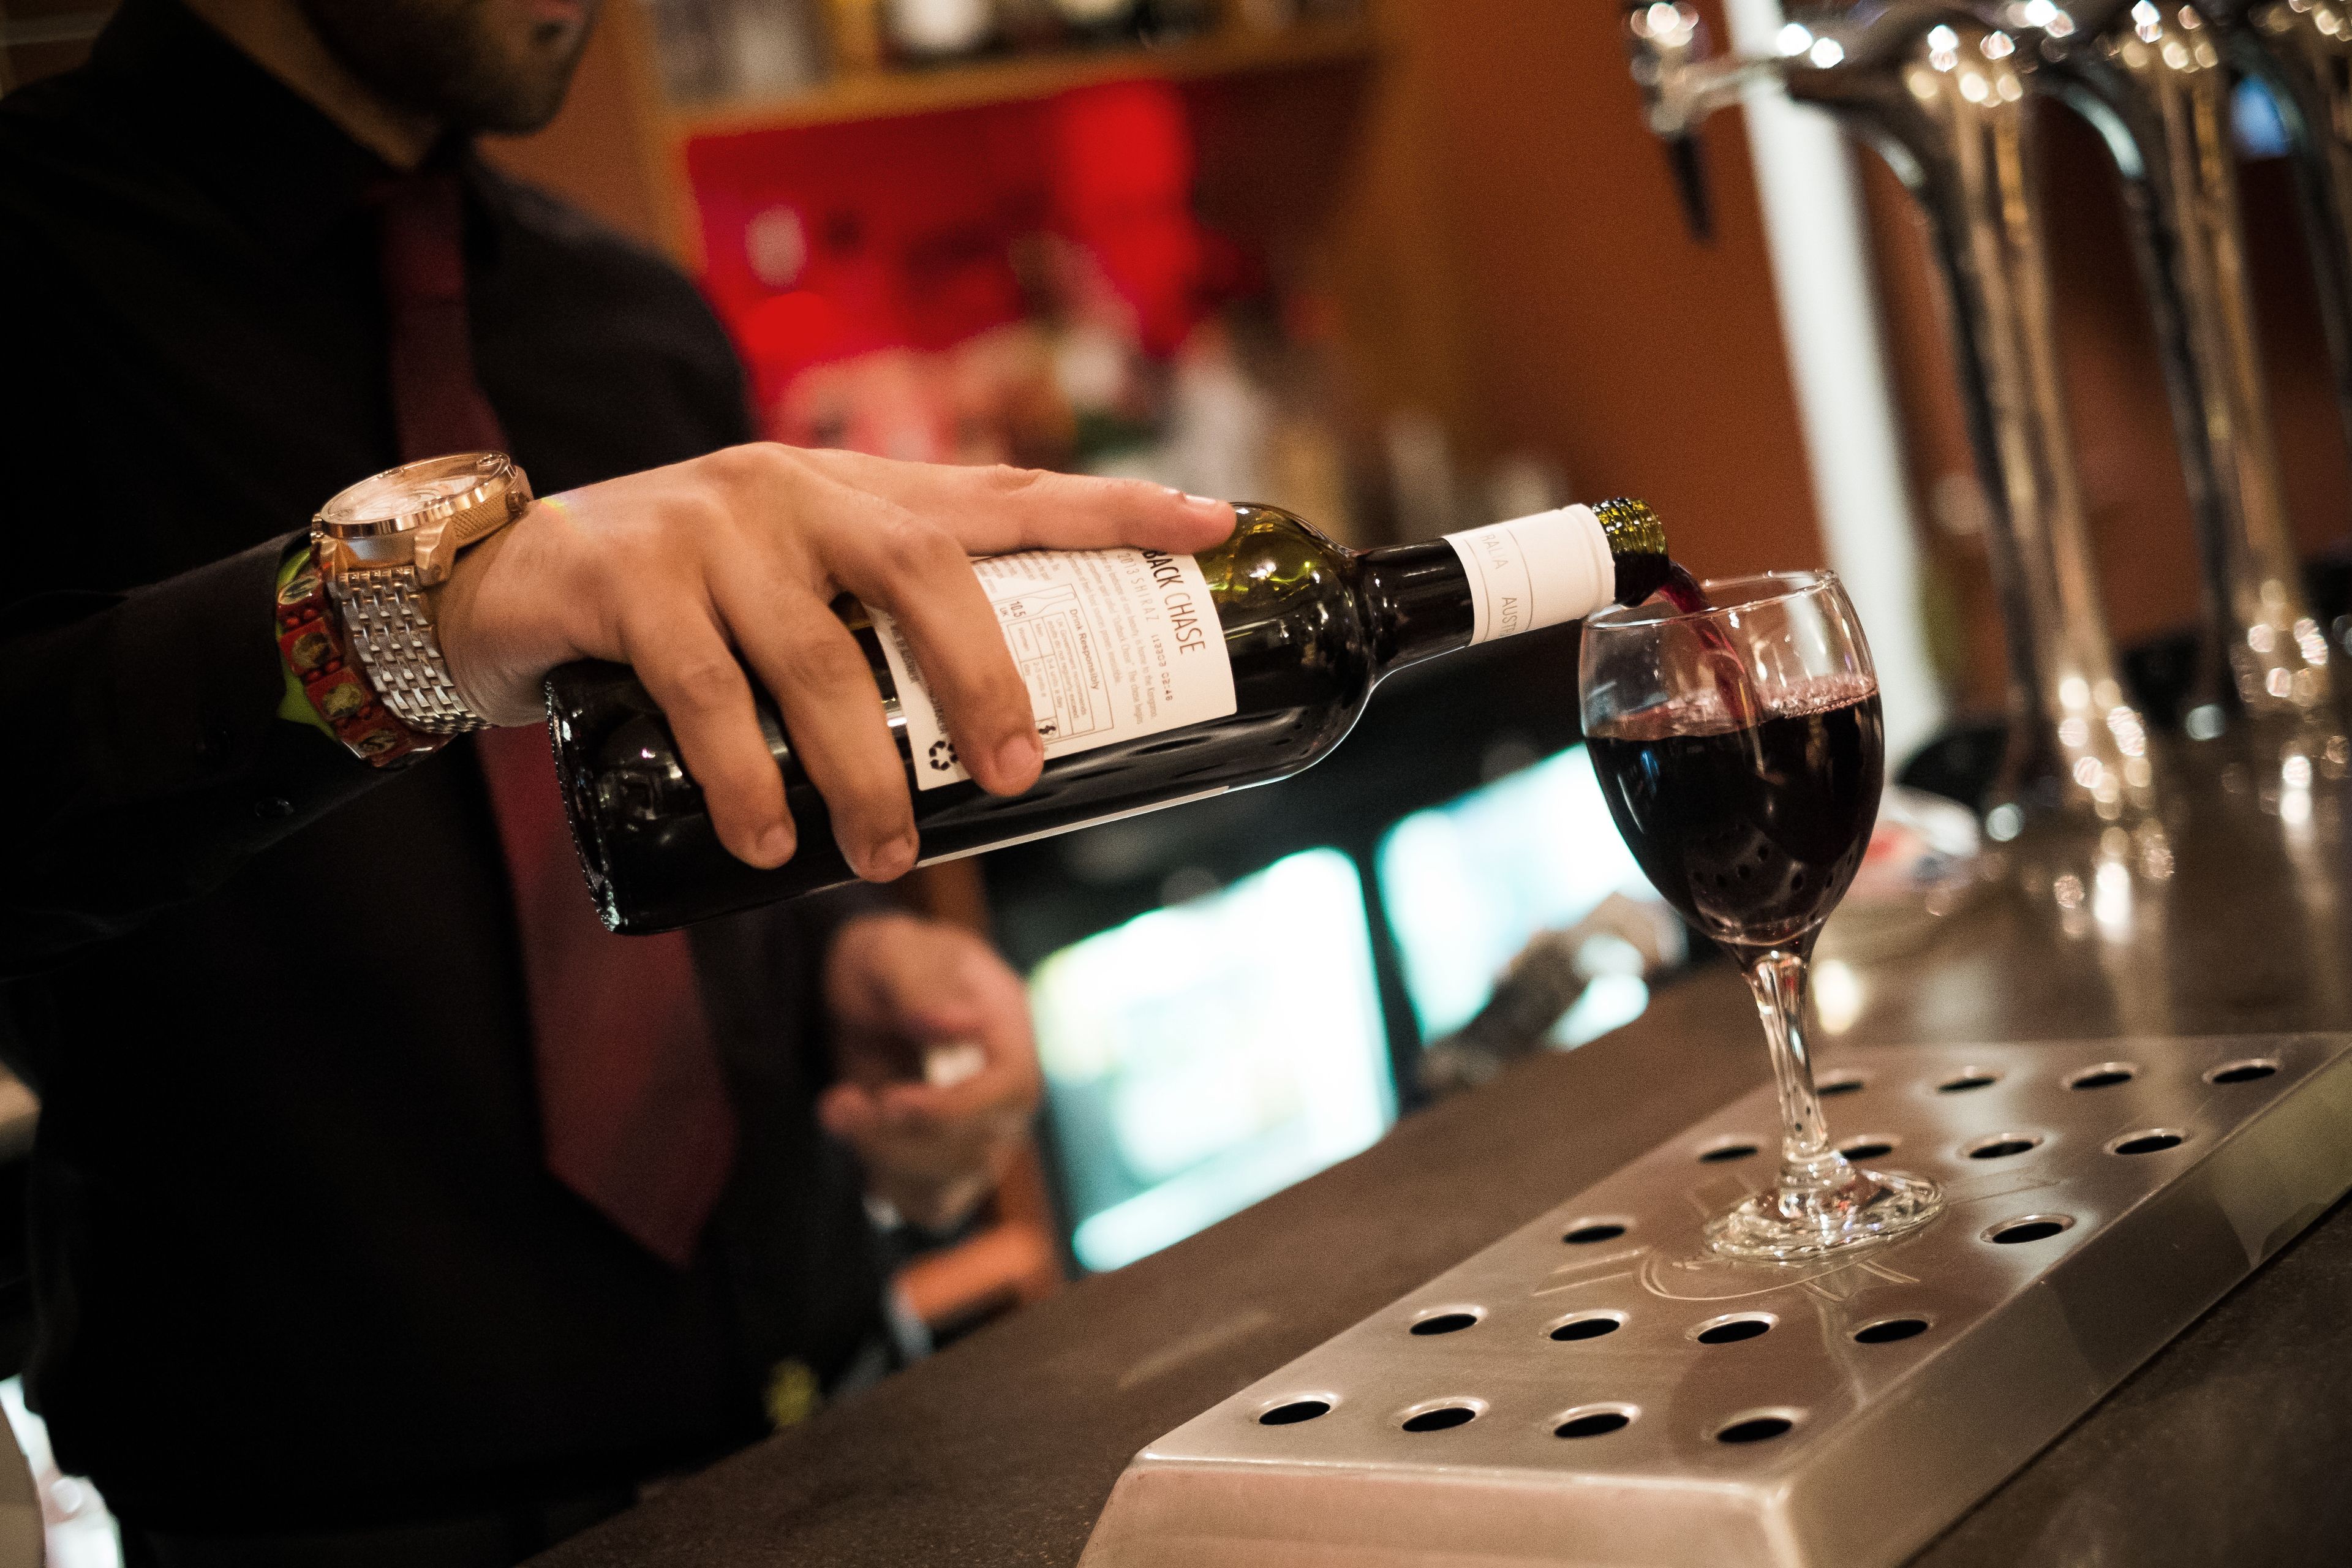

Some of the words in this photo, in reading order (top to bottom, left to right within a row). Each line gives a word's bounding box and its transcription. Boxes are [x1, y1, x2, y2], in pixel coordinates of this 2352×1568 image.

[1117, 552, 1139, 575] 2013
[1131, 577, 1159, 622] SHIRAZ
[999, 607, 1009, 617] UK
[1009, 601, 1026, 617] 10.5
[1499, 597, 1517, 637] AUSTR
[1047, 620, 1058, 638] adults
[1164, 590, 1205, 655] CHASE
[1054, 639, 1061, 648] do
[1069, 608, 1084, 631] Drink
[1078, 633, 1099, 690] Responsibly
[1057, 650, 1066, 661] not
[1137, 645, 1147, 665] home
[1055, 618, 1063, 628] UK
[1060, 629, 1077, 669] Government
[1072, 671, 1087, 715] recommends
[1061, 662, 1075, 691] regularly
[1050, 671, 1059, 687] units
